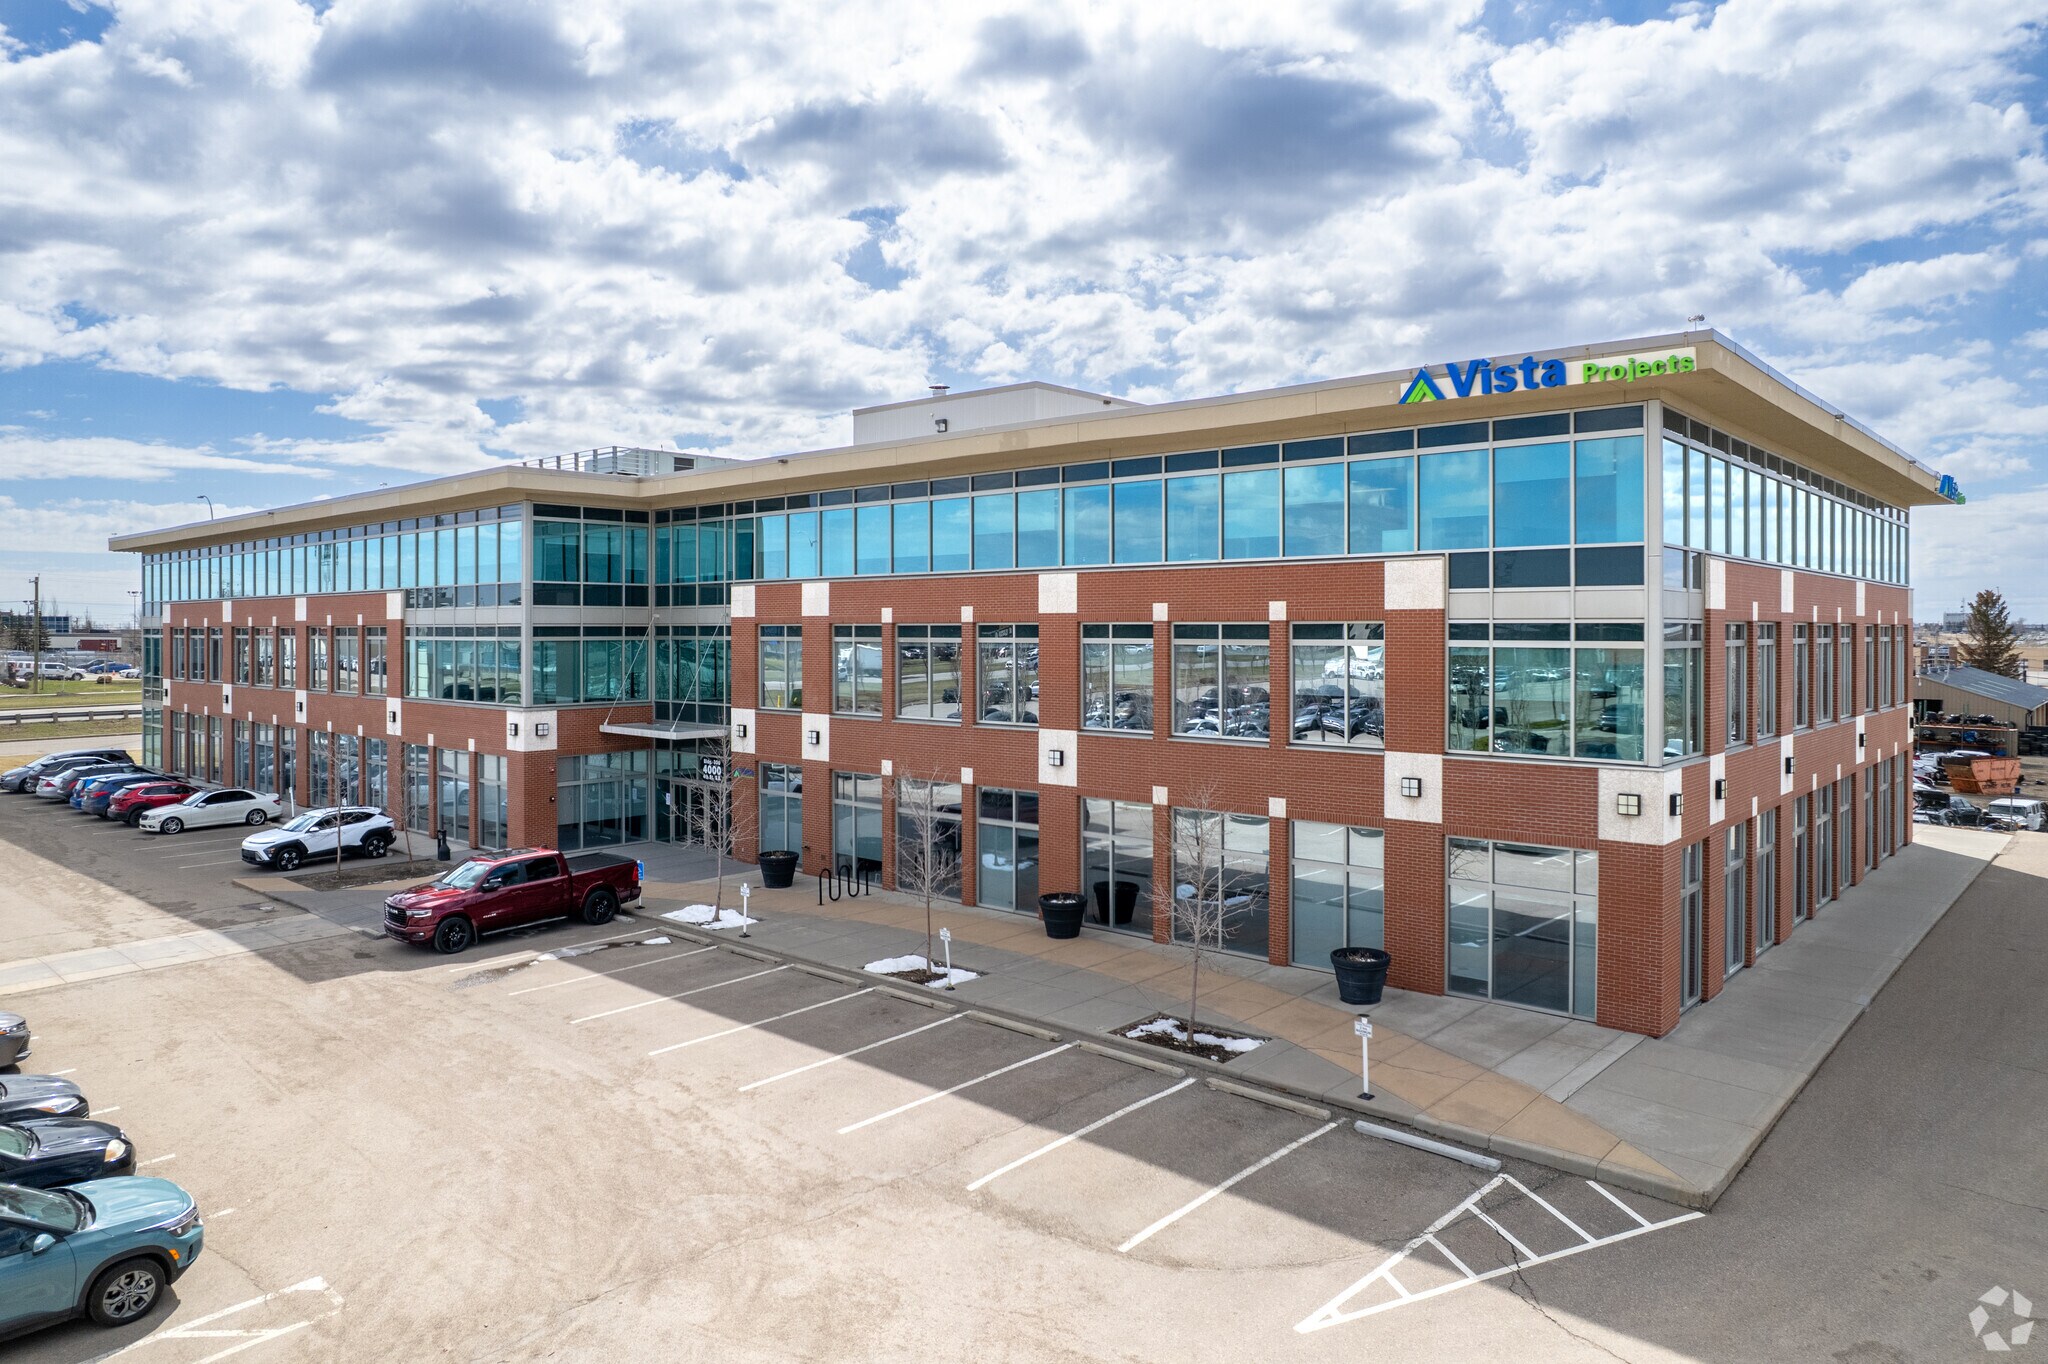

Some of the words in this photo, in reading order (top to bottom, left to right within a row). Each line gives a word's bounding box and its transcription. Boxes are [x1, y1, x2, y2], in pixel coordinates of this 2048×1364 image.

[1446, 355, 1567, 397] Vista
[1582, 354, 1695, 383] Projects
[703, 765, 721, 775] 4000
